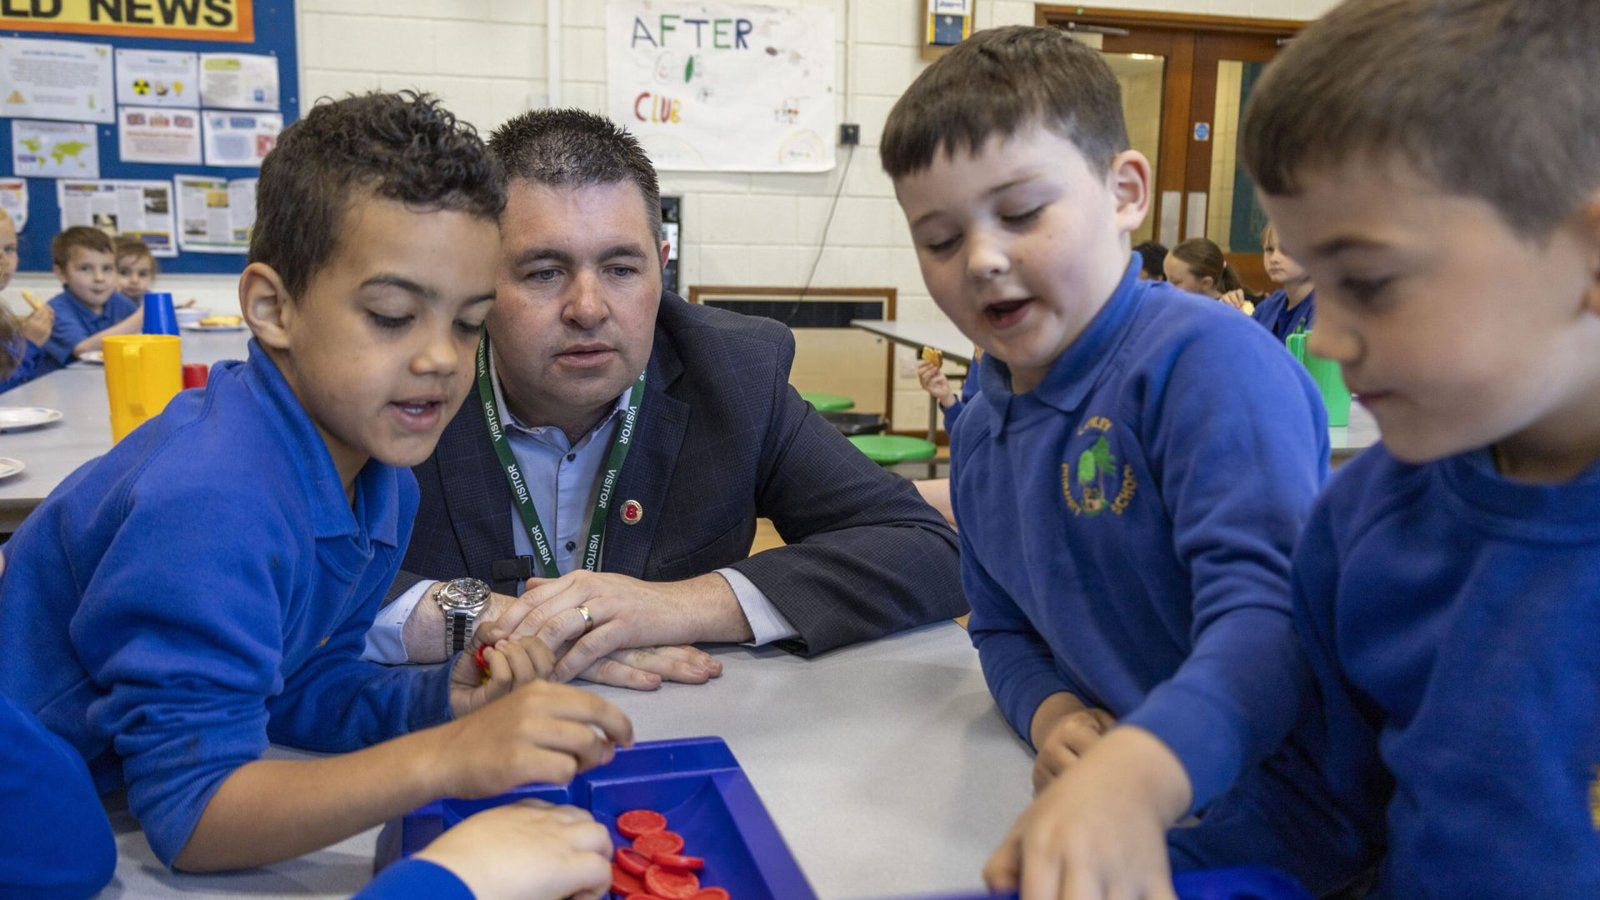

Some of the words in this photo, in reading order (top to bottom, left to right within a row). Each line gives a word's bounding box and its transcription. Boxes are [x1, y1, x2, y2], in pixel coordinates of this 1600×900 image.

[90, 0, 233, 27] NEWS
[631, 14, 753, 49] AFTER
[634, 91, 682, 124] CLUB
[485, 400, 502, 442] VISITOR
[619, 406, 637, 445] VISITOR
[507, 463, 529, 505] VISITOR
[598, 469, 617, 509] VISITOR
[531, 524, 552, 566] VISITOR
